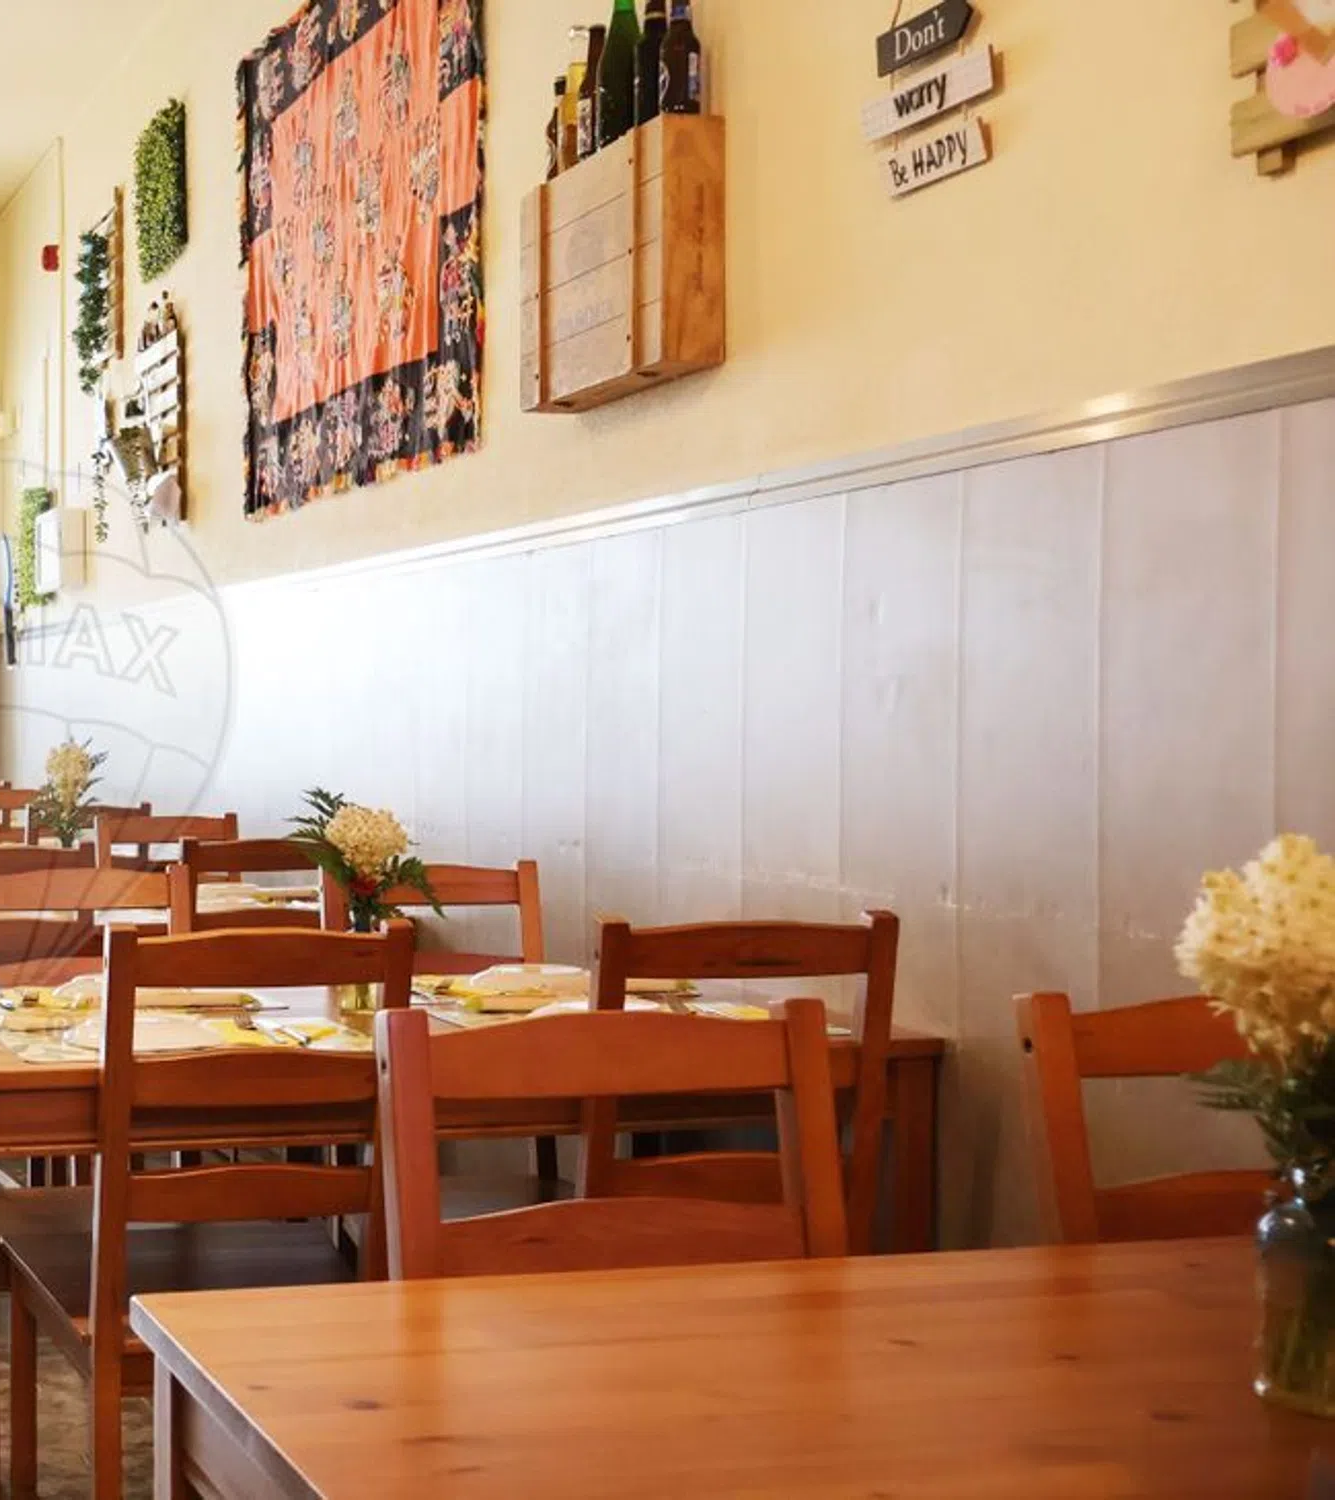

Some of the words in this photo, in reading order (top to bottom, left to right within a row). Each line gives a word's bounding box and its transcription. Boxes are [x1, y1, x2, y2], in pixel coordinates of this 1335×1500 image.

[894, 11, 945, 61] Don't
[888, 159, 909, 187] Be
[912, 130, 967, 177] HAPPY
